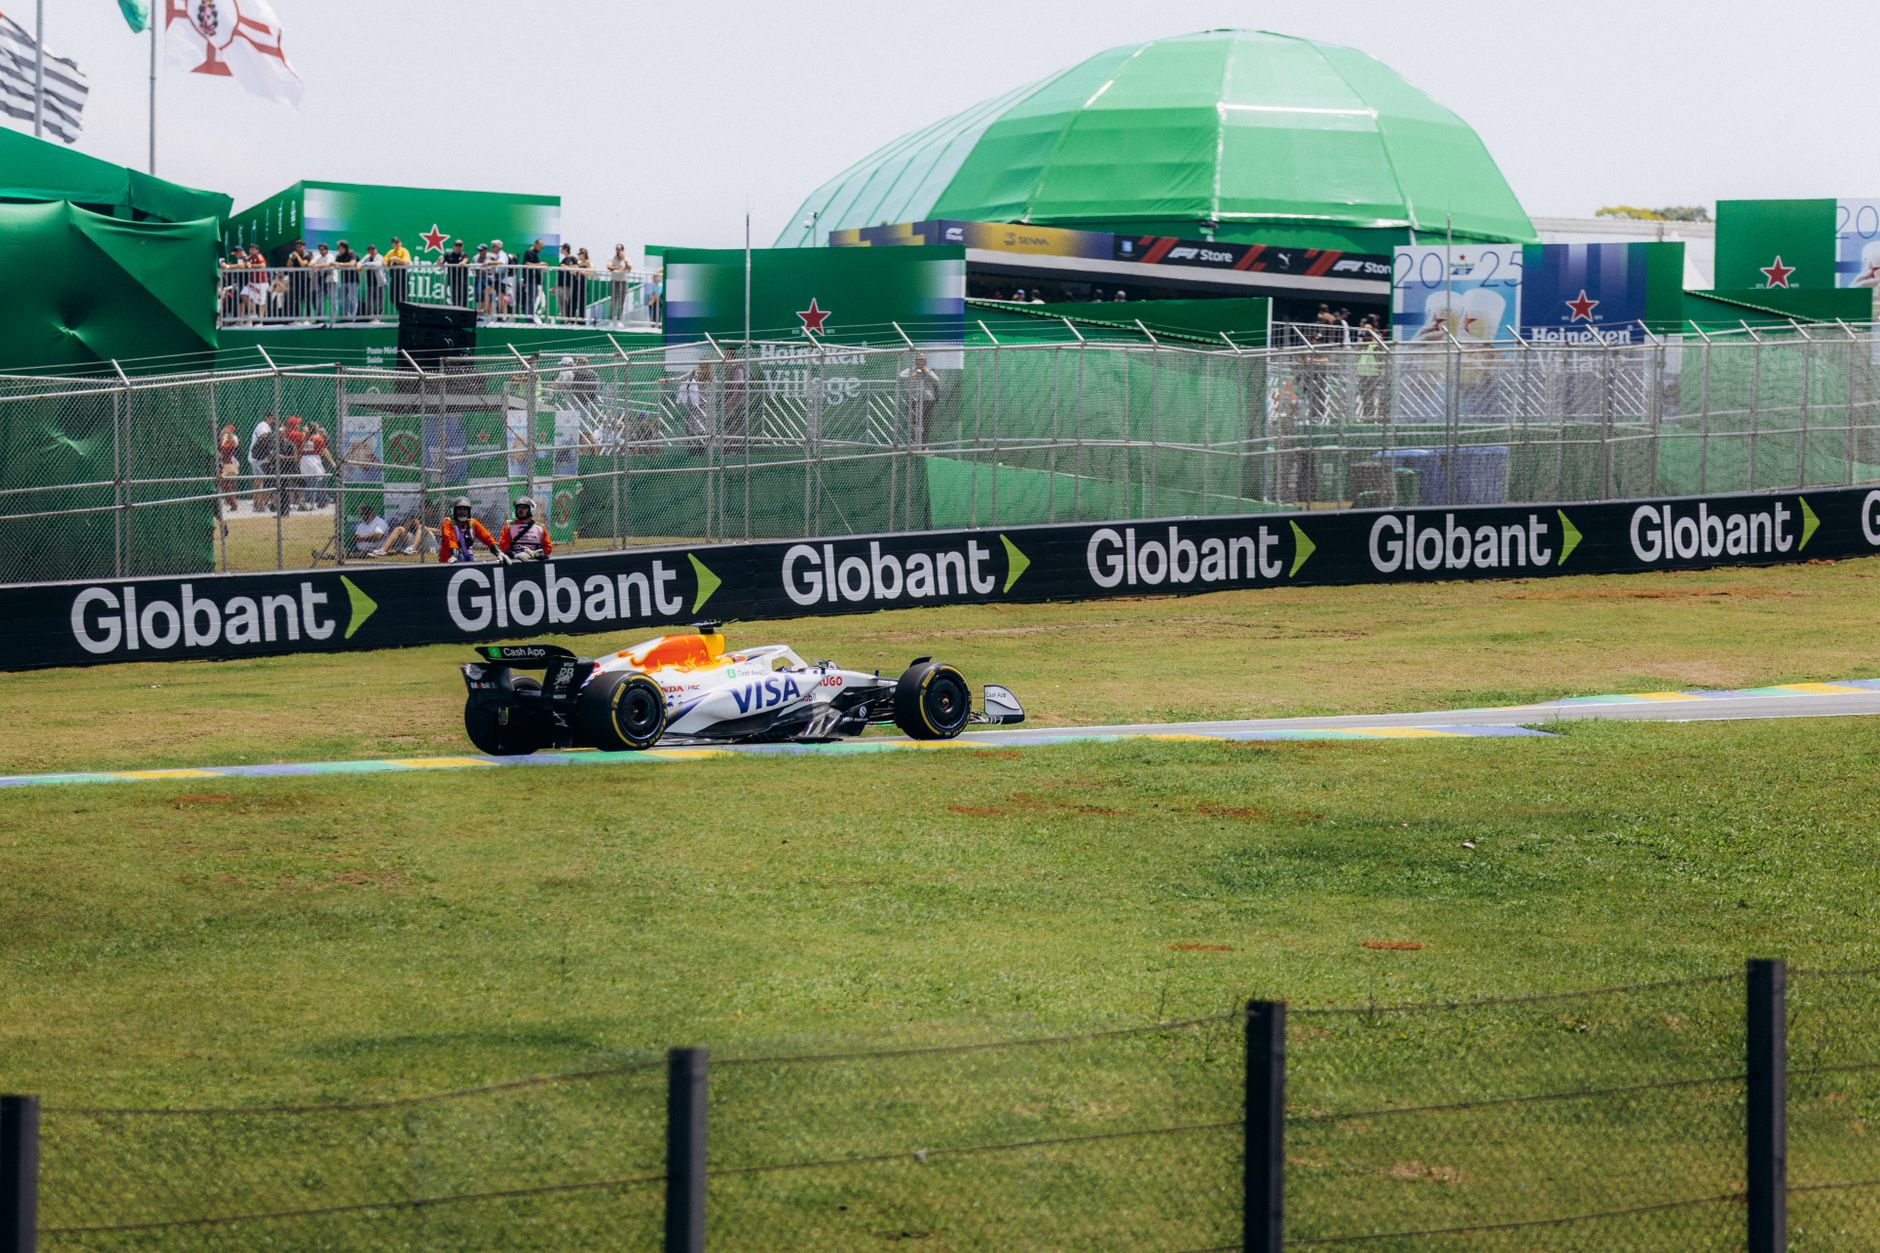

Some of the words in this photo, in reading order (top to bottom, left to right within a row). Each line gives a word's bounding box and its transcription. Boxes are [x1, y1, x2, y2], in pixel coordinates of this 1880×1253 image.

[1200, 249, 1233, 262] Store
[1531, 327, 1633, 346] Heineken
[1087, 526, 1283, 588] Globant
[1369, 513, 1551, 573] Globant
[1630, 502, 1793, 562] Globant
[447, 560, 683, 632] Globant
[782, 540, 995, 606] Globant
[71, 582, 336, 654] Globant
[503, 648, 526, 656] Cash
[527, 648, 546, 657] App
[727, 674, 801, 714] VISA
